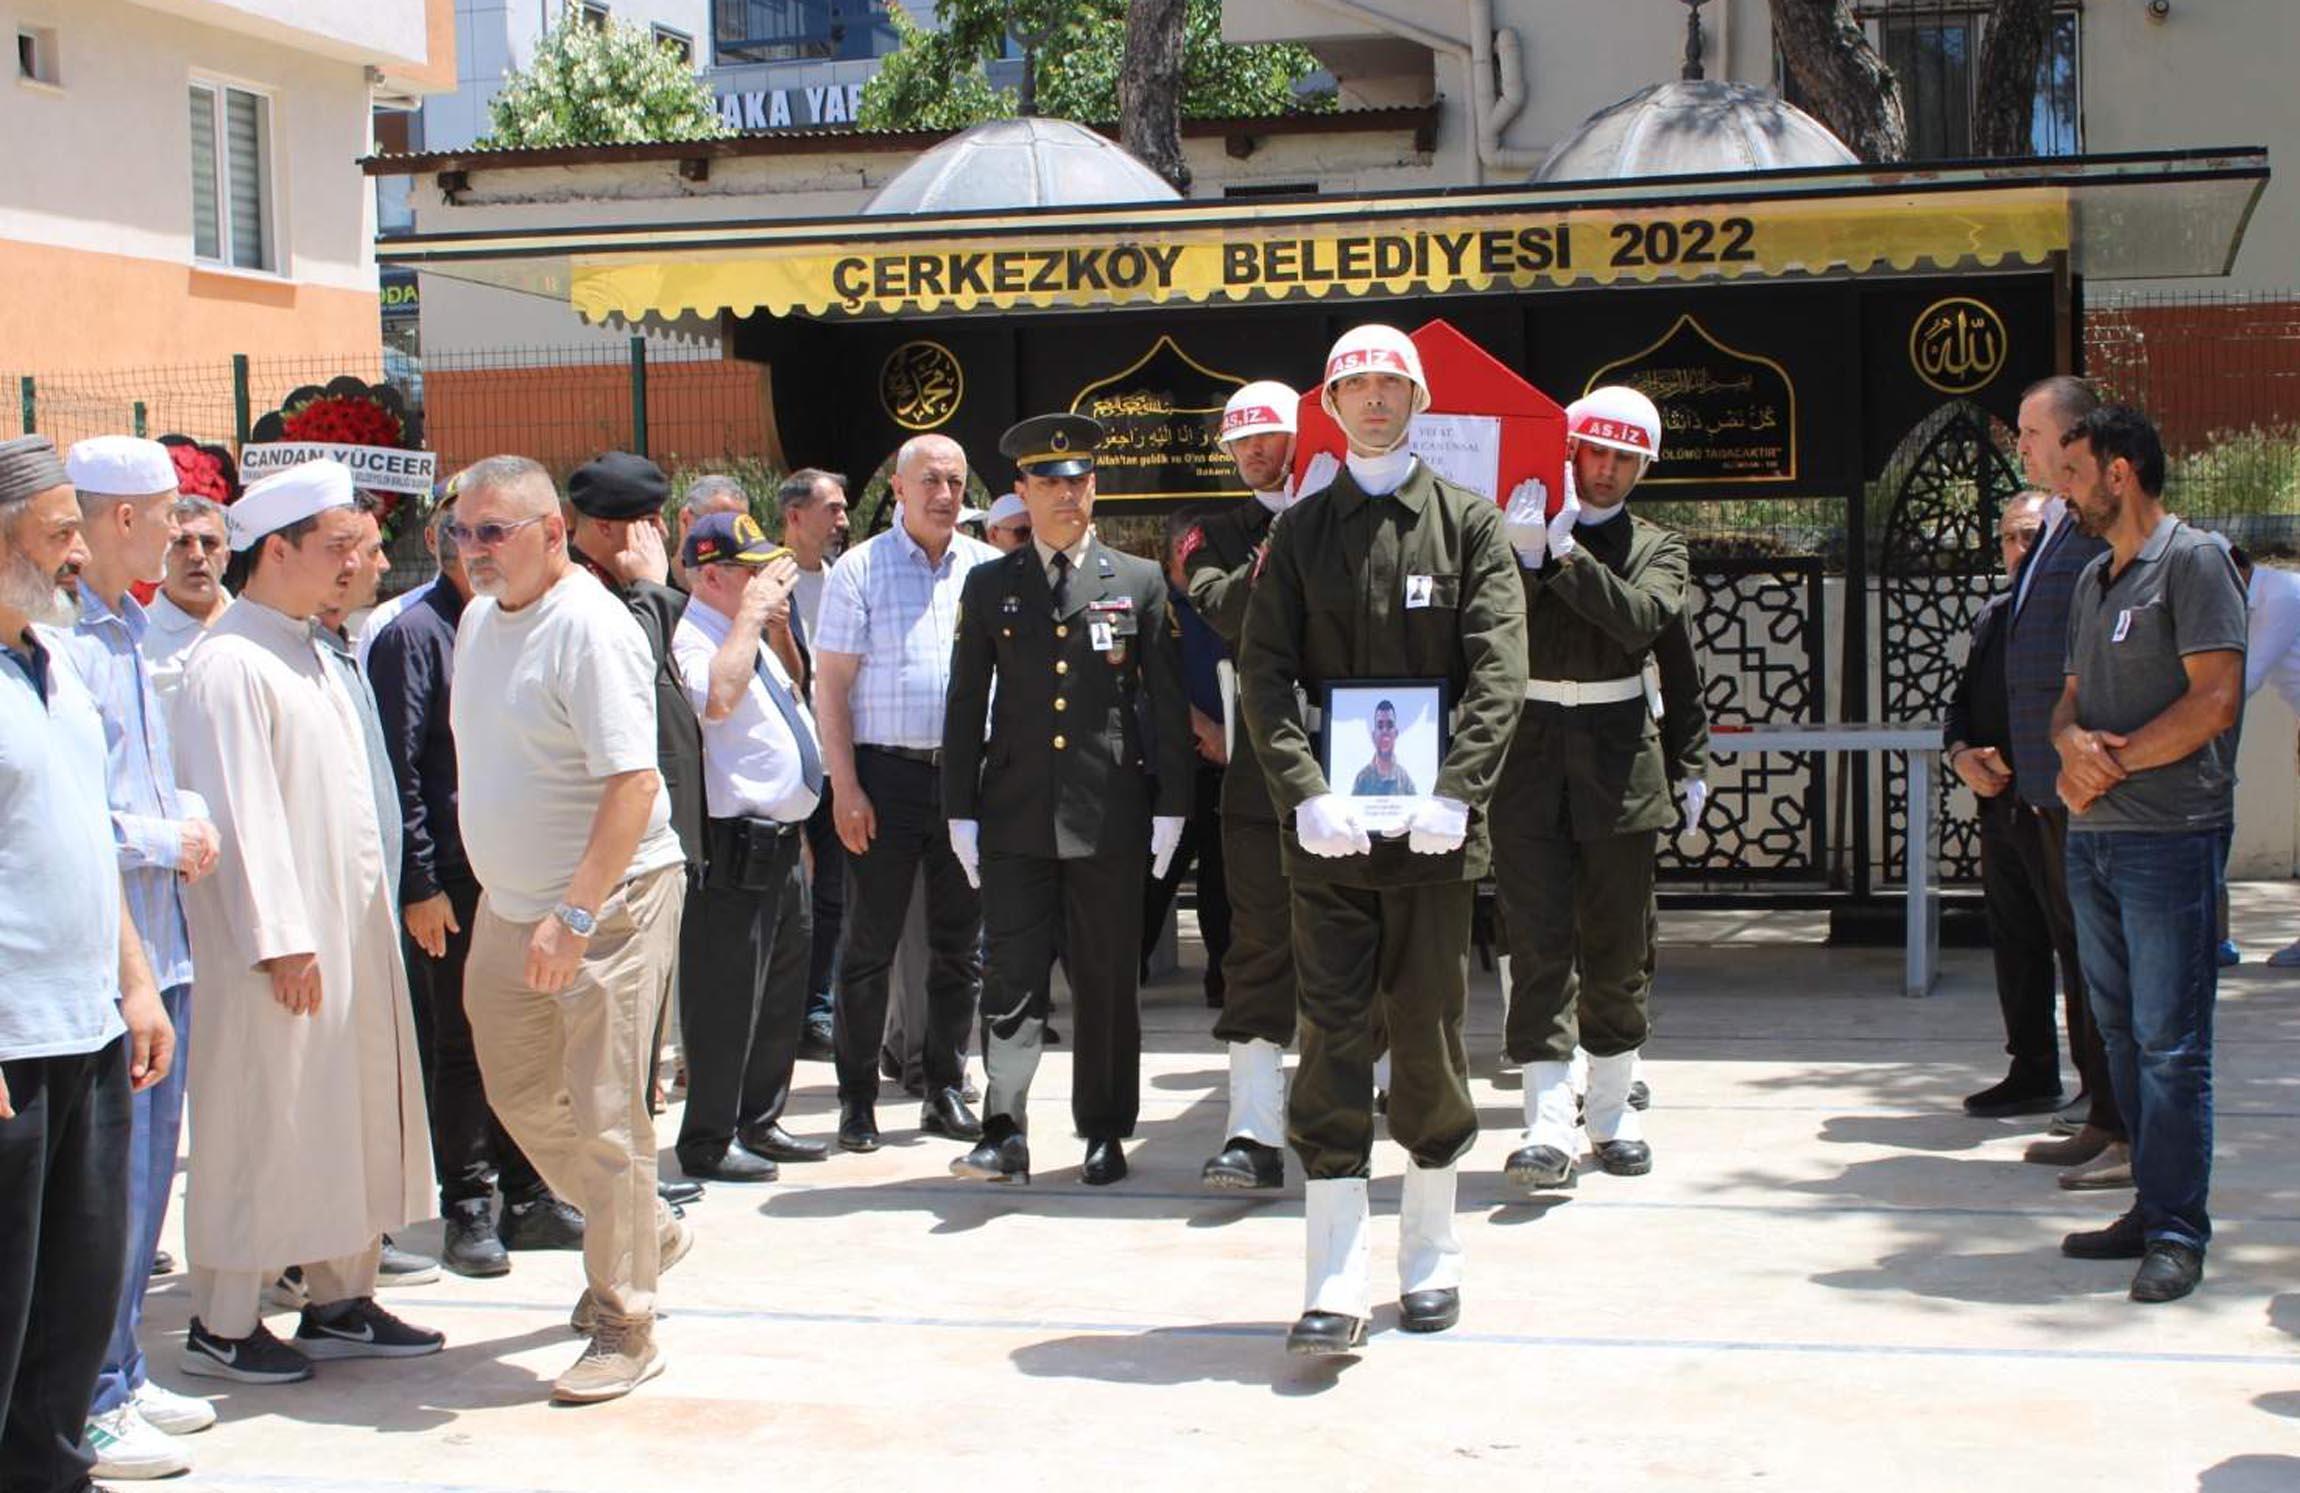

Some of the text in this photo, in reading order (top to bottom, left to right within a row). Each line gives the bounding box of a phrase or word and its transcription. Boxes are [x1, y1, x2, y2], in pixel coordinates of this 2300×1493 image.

[832, 217, 1755, 309] ÇERKEZKÖY BELEDİYESİ 2022
[381, 284, 418, 305] DA
[243, 447, 433, 477] CANDAN YÜCEER
